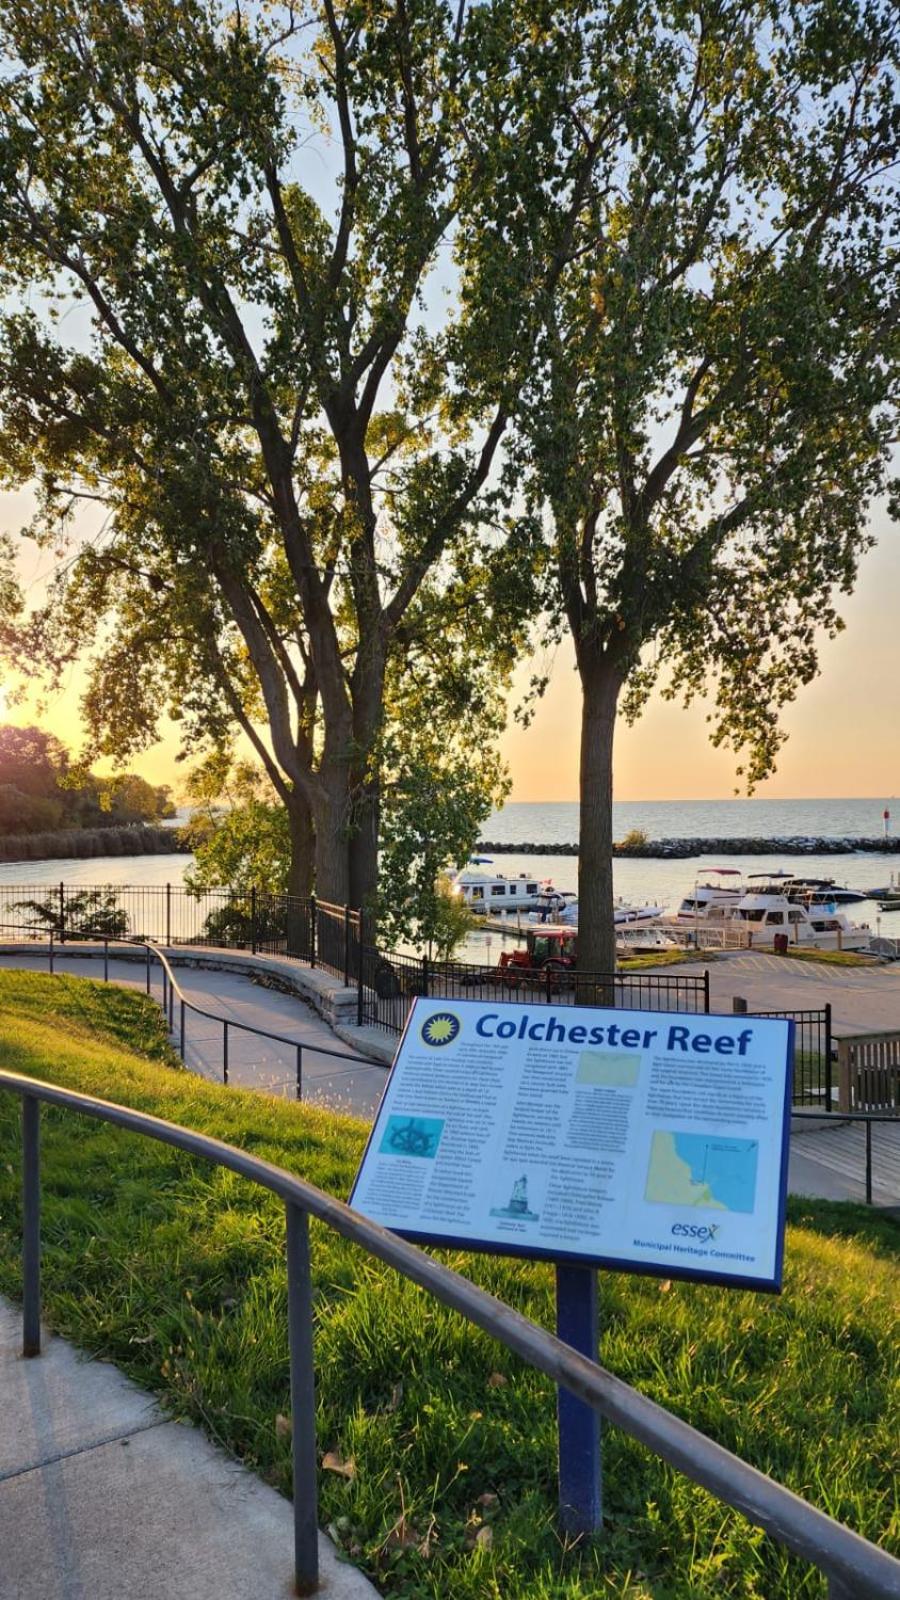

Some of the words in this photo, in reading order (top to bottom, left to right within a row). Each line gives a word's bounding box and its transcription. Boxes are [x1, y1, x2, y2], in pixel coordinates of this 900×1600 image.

[475, 1013, 658, 1049] Colchester
[667, 1026, 753, 1055] Reef
[671, 1222, 720, 1244] essex
[633, 1239, 672, 1252] Municipal
[673, 1244, 708, 1257] Heritage
[709, 1249, 756, 1262] Committee
